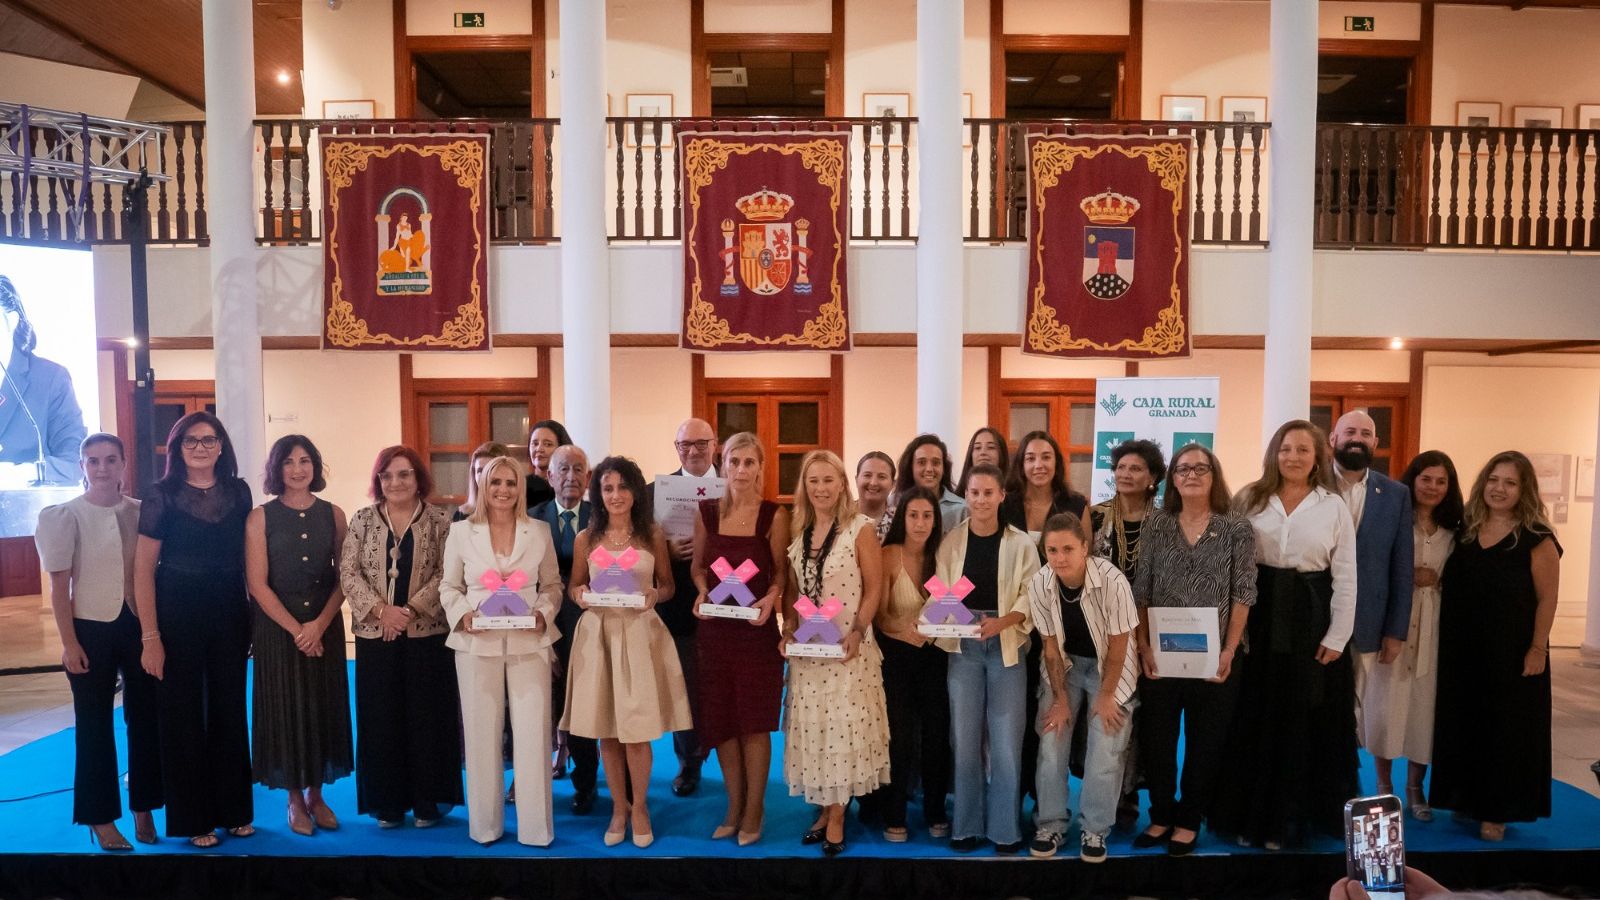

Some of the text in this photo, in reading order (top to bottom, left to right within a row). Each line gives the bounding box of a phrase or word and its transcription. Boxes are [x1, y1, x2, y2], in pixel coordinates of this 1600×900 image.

[1132, 397, 1215, 408] CAJA RURAL
[1148, 409, 1197, 417] GRANADA
